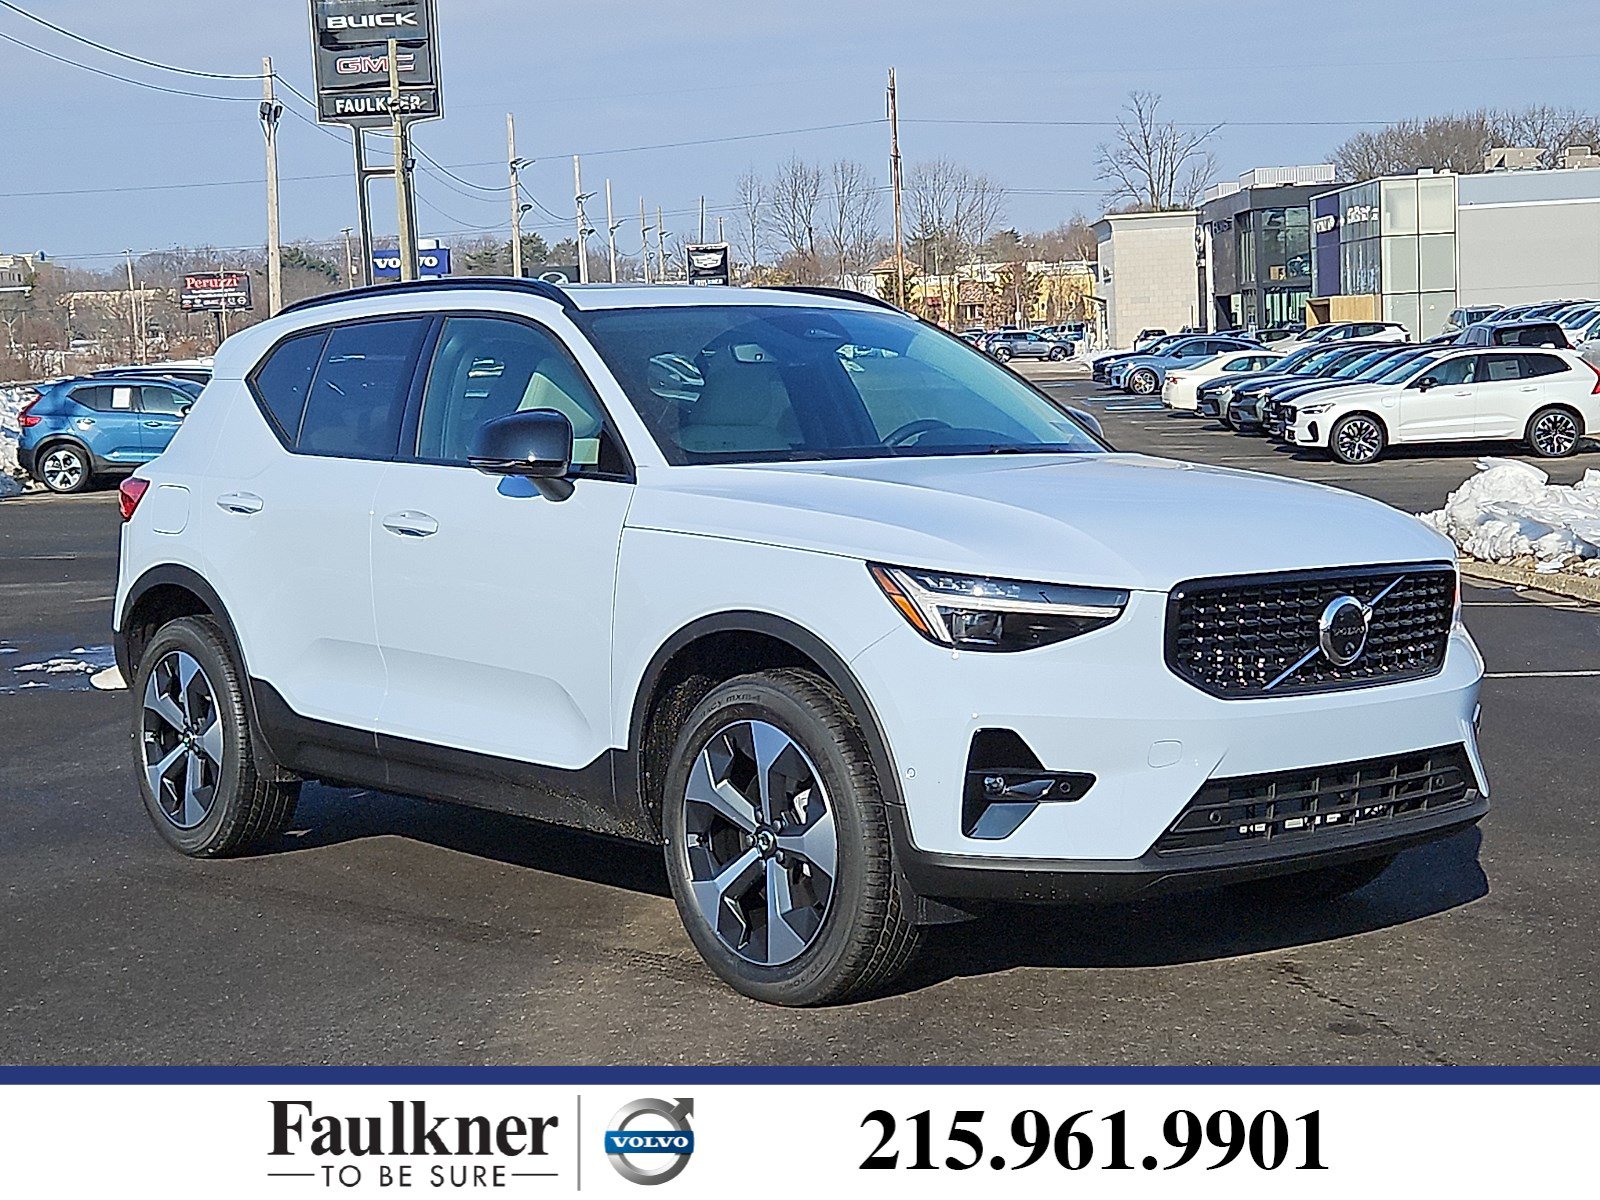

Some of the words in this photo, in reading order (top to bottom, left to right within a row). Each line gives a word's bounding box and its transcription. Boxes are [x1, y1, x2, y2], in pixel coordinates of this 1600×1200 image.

[326, 12, 418, 29] BUICK
[336, 53, 415, 74] GMC
[373, 256, 438, 269] VOVO
[185, 275, 239, 290] Peruzzi
